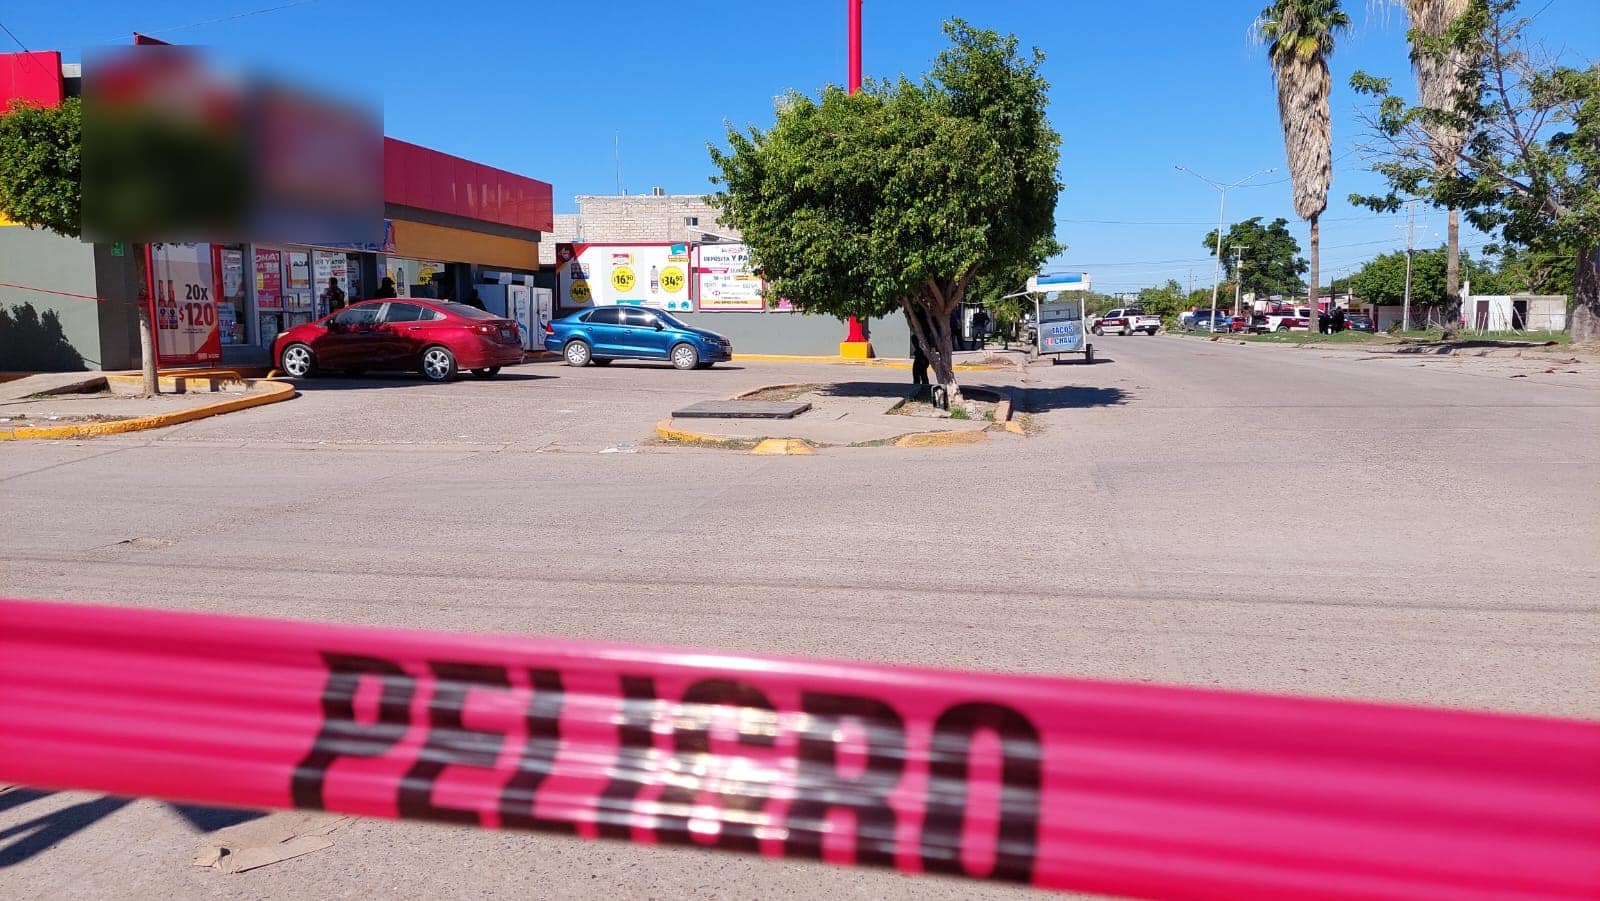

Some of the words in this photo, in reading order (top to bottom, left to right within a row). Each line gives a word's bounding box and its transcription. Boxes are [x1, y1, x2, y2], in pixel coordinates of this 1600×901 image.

[185, 284, 208, 300] 20x
[179, 302, 214, 326] $120
[291, 651, 1044, 883] PELIGRO
